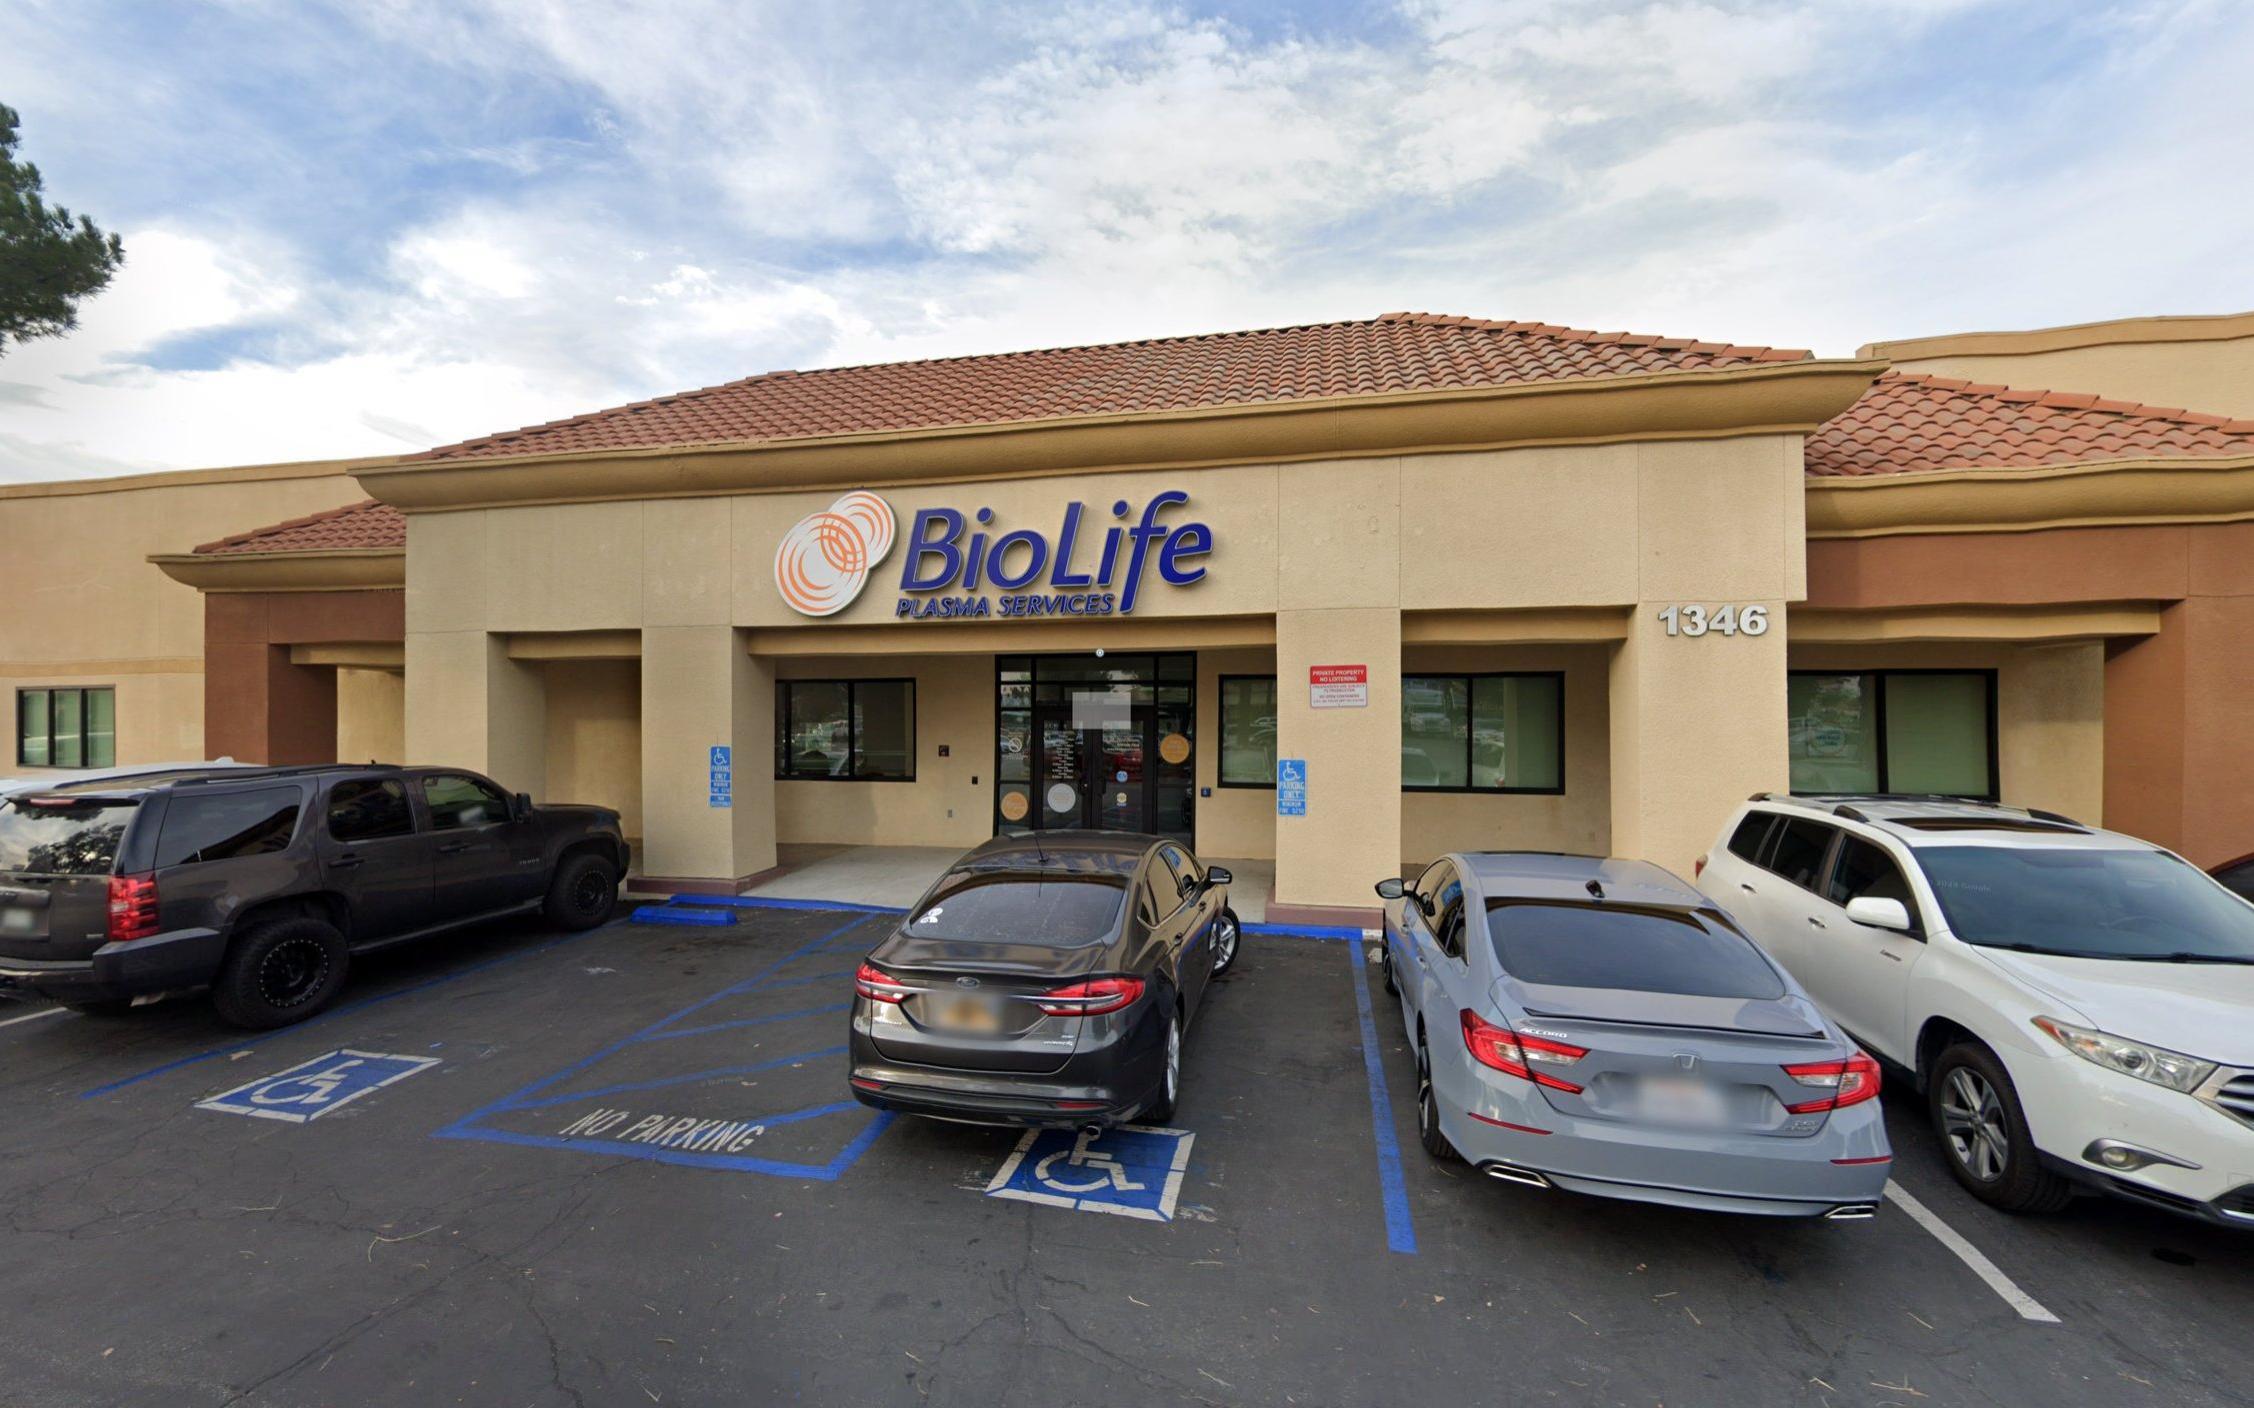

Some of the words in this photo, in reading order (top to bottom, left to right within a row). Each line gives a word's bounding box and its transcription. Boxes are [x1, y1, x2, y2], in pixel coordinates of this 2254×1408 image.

[899, 490, 1214, 613] BioLife
[895, 596, 990, 618] PLASMA
[998, 593, 1117, 616] SERVICES
[1657, 604, 1769, 637] 1346
[1278, 781, 1305, 790] PARKING
[1283, 790, 1301, 798] ONLY
[1519, 1027, 1568, 1038] ACCORD
[558, 1108, 630, 1136] NO
[616, 1114, 765, 1152] PARKING
